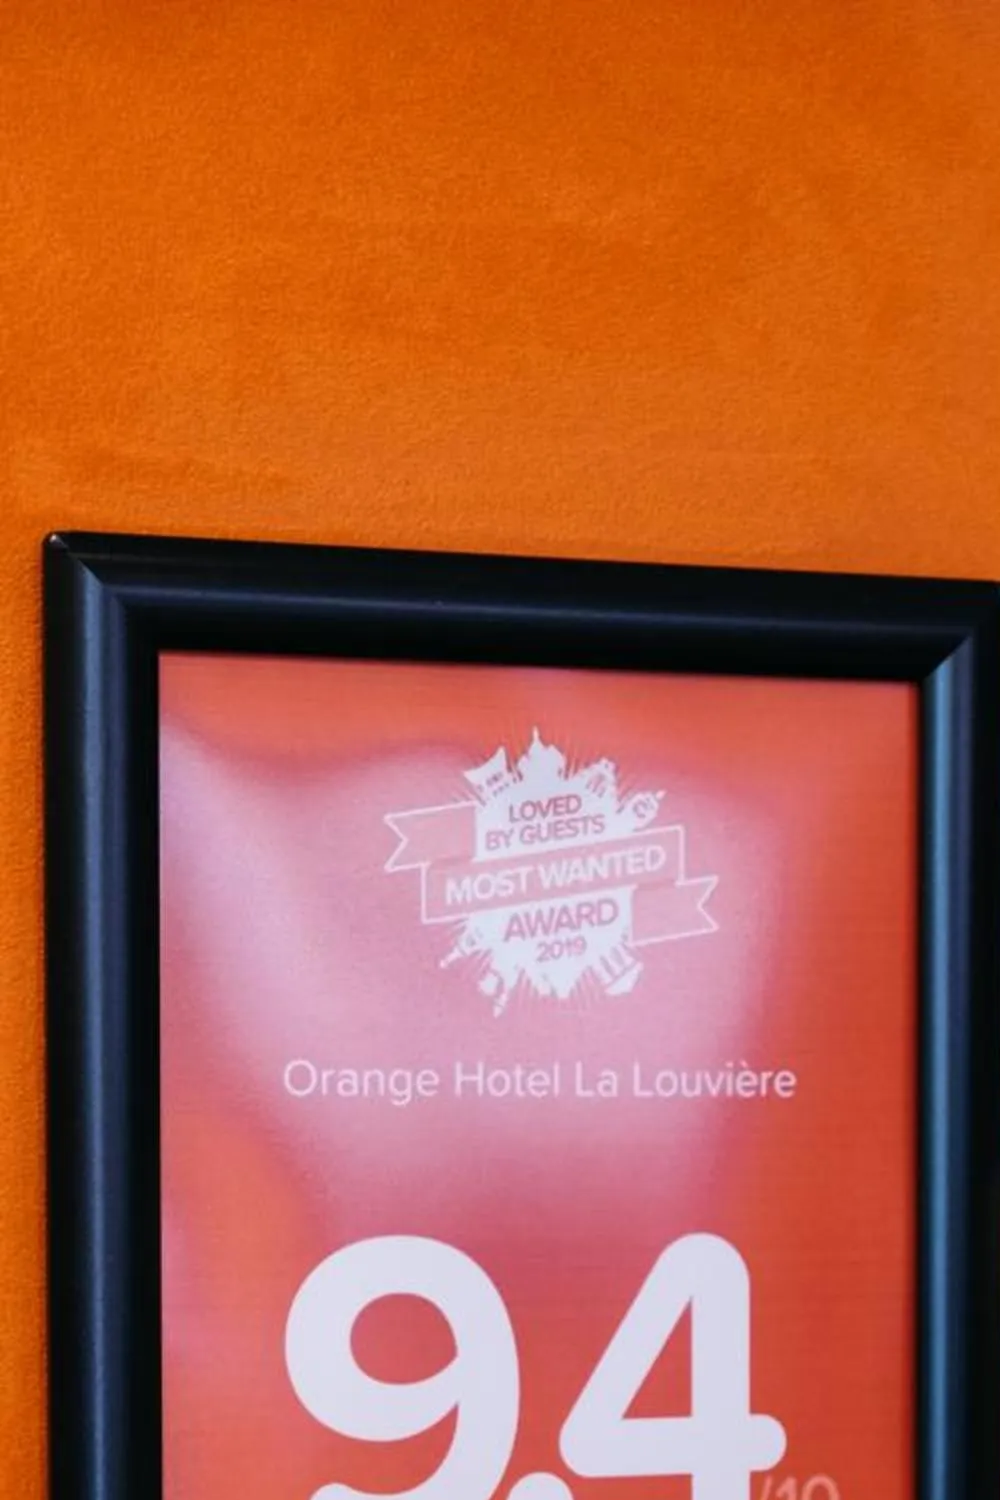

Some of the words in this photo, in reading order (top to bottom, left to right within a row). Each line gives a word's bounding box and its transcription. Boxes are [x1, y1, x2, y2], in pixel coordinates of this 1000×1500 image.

[508, 794, 583, 823] LOVED
[485, 827, 514, 851] BY
[518, 814, 606, 844] GUESTS
[445, 866, 535, 906] MOST
[538, 844, 667, 891] WANTED
[503, 898, 620, 943] AWARD
[535, 937, 588, 963] 2019
[283, 1059, 439, 1105] Orange
[454, 1061, 560, 1097] Hotel
[574, 1062, 619, 1097] La
[632, 1061, 797, 1098] Louvière
